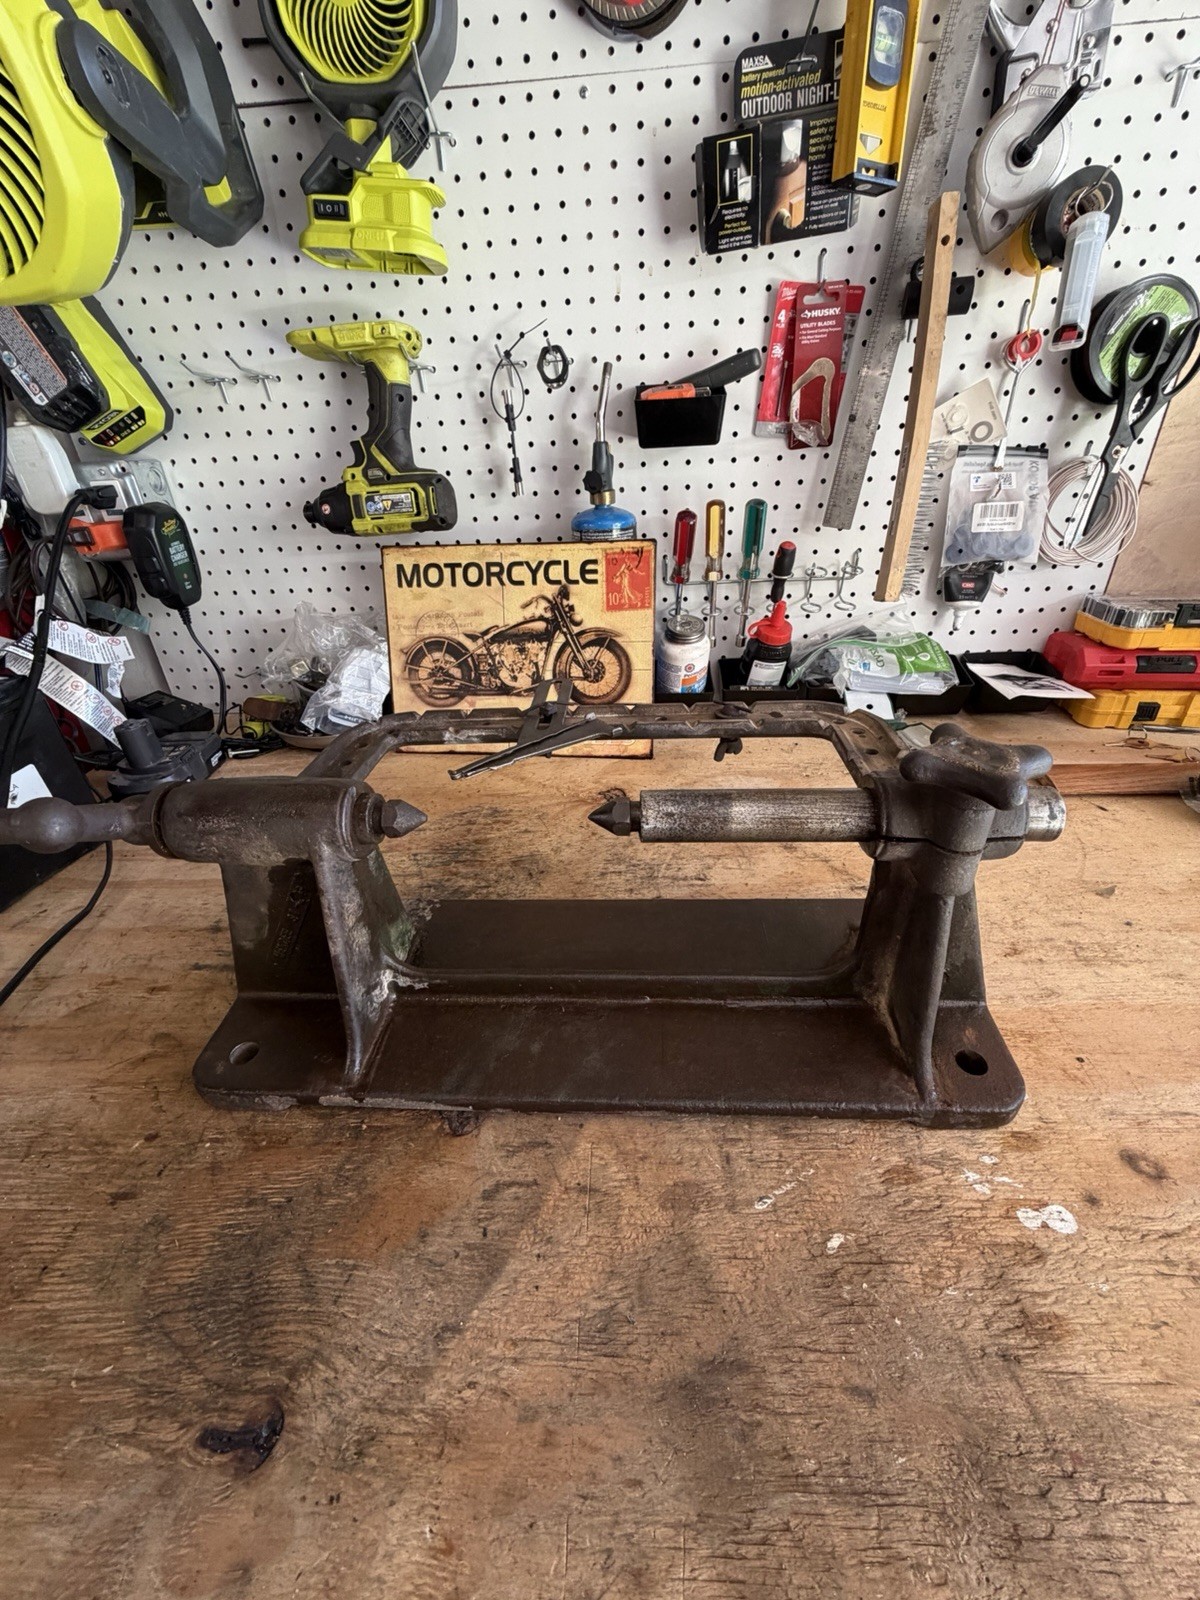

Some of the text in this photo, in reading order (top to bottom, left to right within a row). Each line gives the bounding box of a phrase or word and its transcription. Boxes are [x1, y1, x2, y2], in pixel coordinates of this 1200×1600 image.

[741, 55, 774, 72] MAXSA
[741, 67, 786, 83] battery powered
[740, 69, 821, 99] motion-activated
[741, 92, 792, 119] OUTDOOR
[777, 309, 786, 323] 4
[811, 307, 841, 318] HUSKY
[396, 559, 599, 588] MOTORCYCLE
